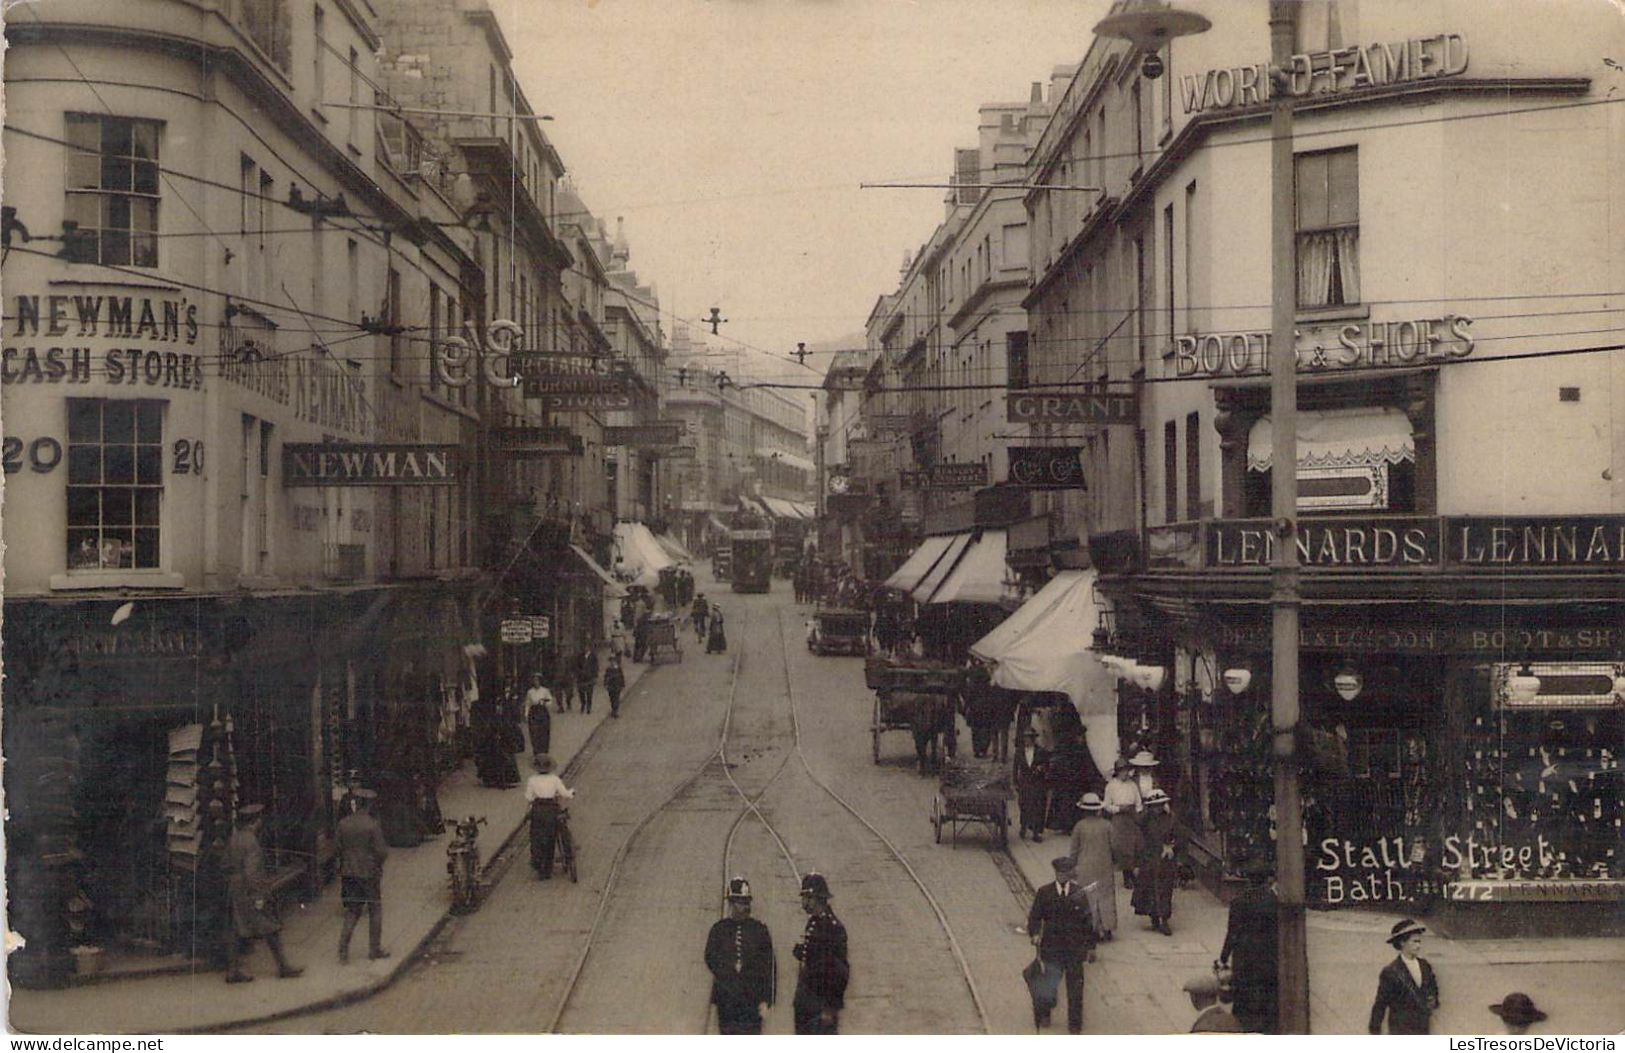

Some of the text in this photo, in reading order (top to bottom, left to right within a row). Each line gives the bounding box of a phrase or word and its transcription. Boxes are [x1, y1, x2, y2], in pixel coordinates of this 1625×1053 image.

[13, 295, 198, 345] NEWMAN'S
[1176, 314, 1475, 376] BOOT & SHOES
[2, 346, 91, 384] CASH
[1015, 396, 1134, 417] GRANT
[3, 437, 62, 474] 20
[171, 439, 205, 476] 20
